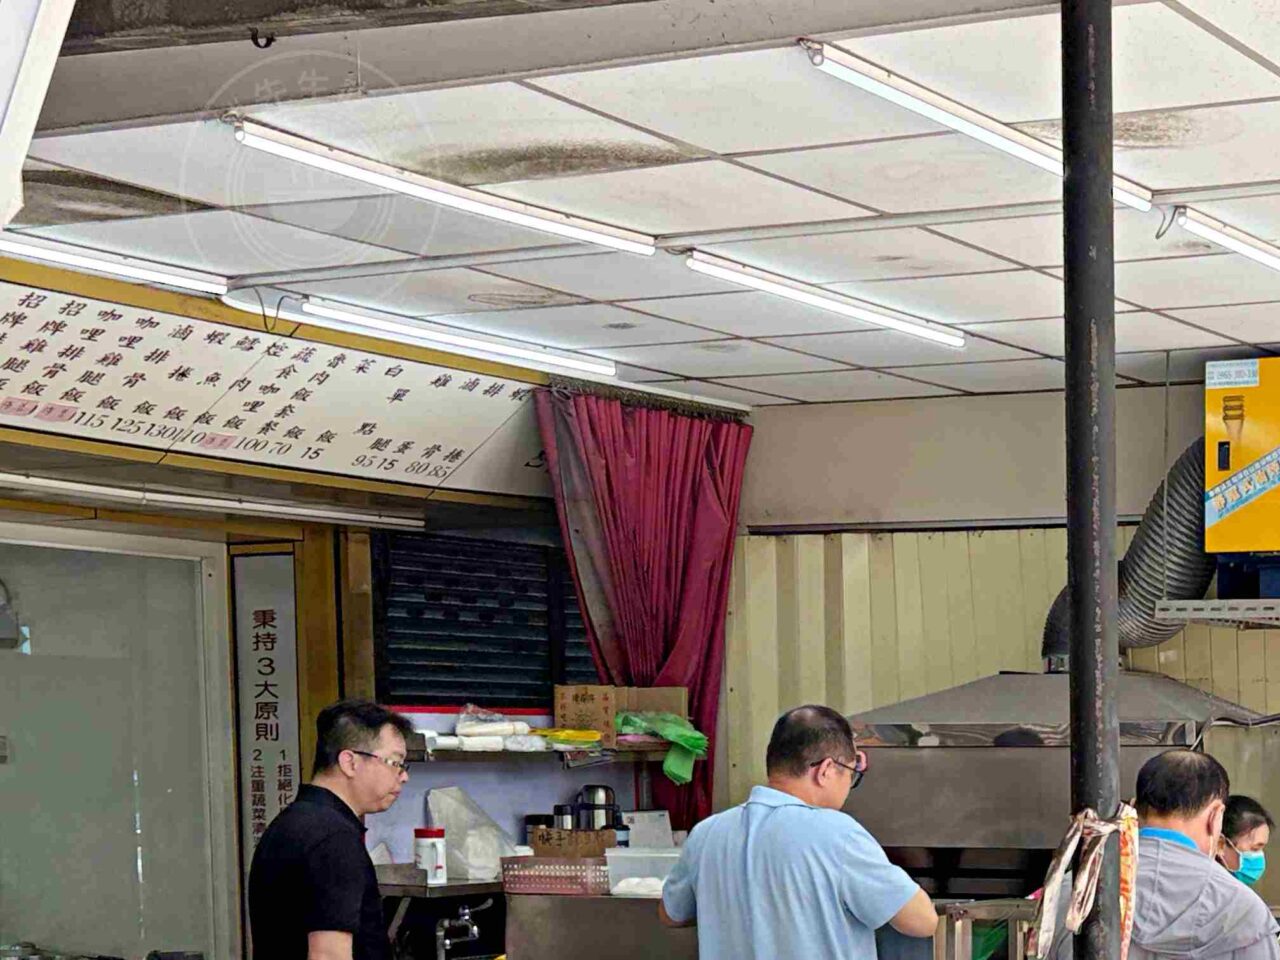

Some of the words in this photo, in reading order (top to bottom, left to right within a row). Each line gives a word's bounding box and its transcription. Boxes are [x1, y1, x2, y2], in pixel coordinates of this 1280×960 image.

[73, 411, 109, 428] 115
[110, 417, 146, 434] 125
[232, 436, 269, 451] 100
[268, 442, 293, 456] 70
[301, 447, 325, 461] 15
[351, 454, 378, 468] 95
[376, 455, 399, 471] 15
[403, 461, 431, 474] 80
[252, 608, 279, 742] 秉持3大原則
[276, 749, 294, 812] 1拒絕化
